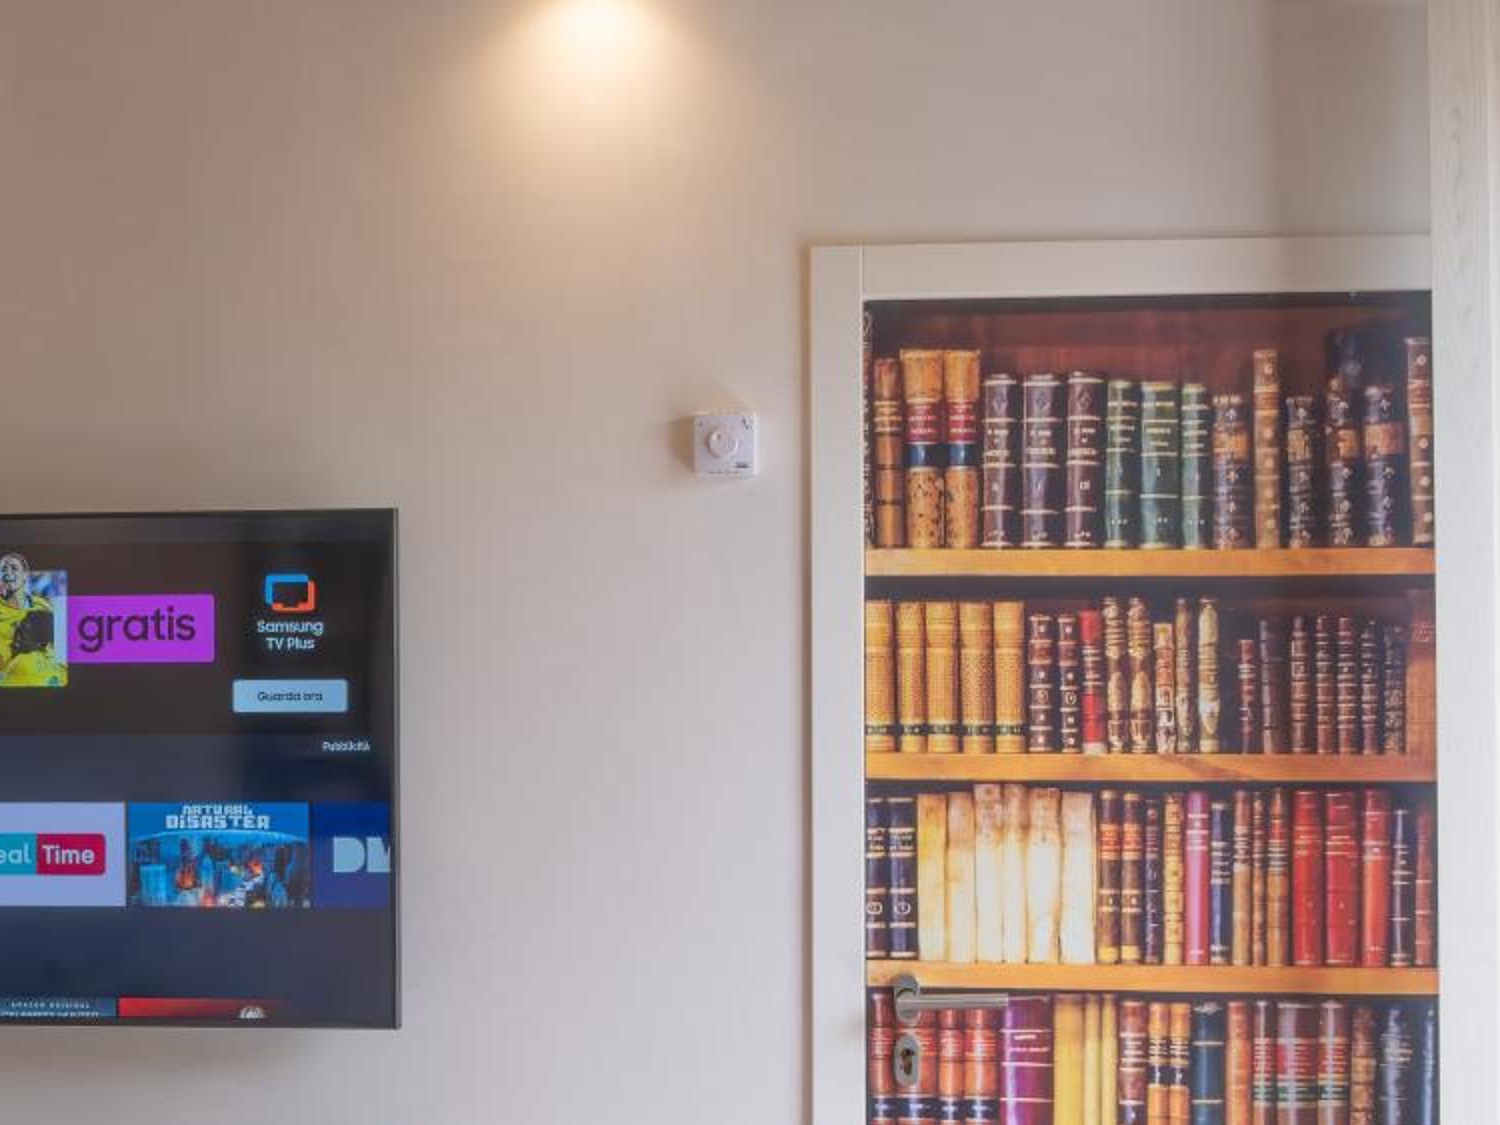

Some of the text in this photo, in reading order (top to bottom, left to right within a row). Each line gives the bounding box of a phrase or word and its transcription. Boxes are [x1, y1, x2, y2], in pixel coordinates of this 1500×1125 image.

[78, 605, 196, 652] gratis
[257, 620, 324, 636] Samsung
[266, 636, 316, 650] TV Plus
[41, 843, 95, 865] Time
